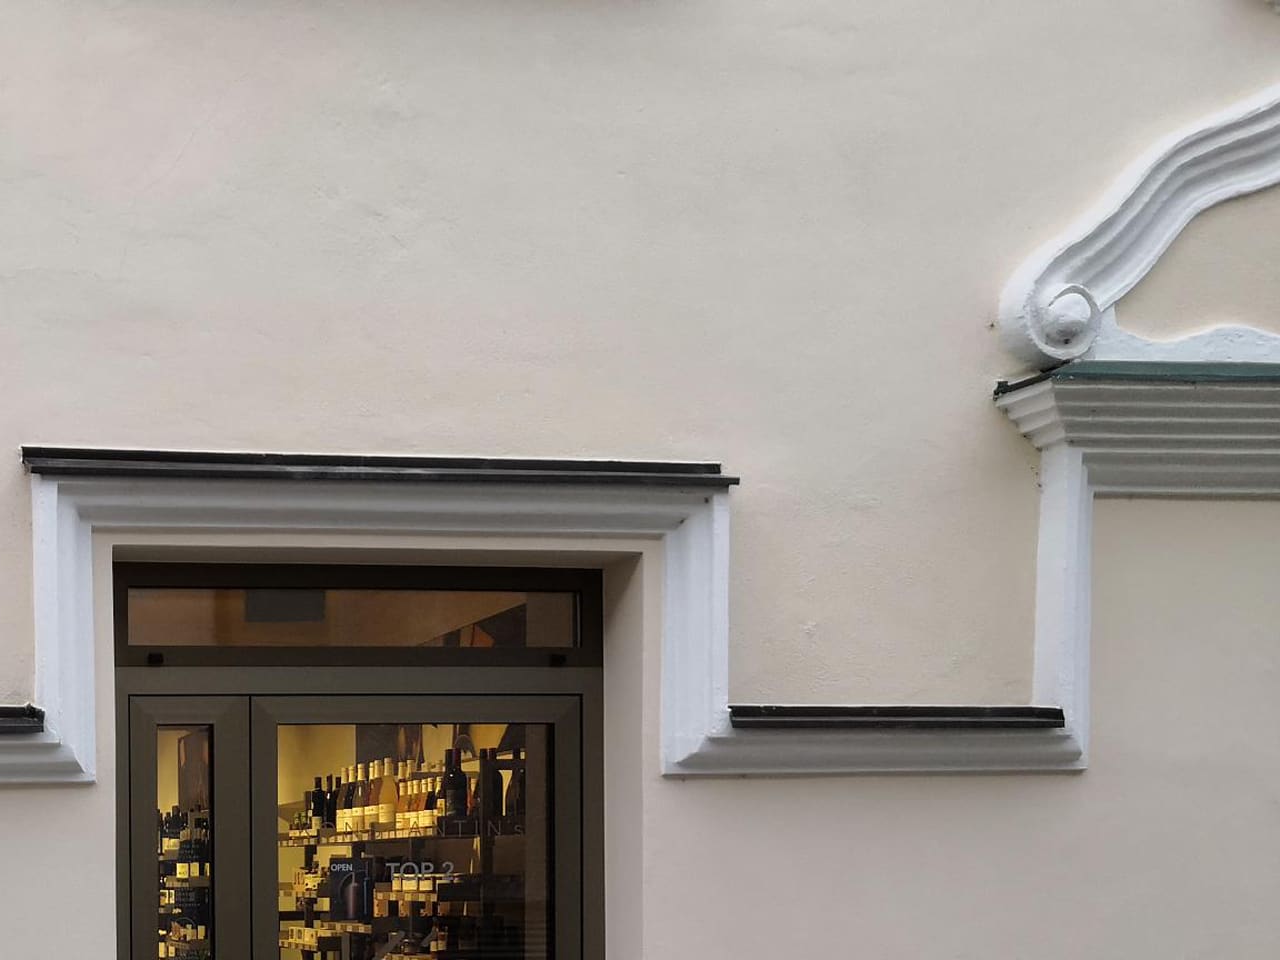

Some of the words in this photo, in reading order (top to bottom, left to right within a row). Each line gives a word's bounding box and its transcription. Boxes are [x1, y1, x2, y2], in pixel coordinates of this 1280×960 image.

[331, 863, 353, 872] OPEN
[386, 861, 434, 881] TOP
[442, 861, 454, 881] 2
